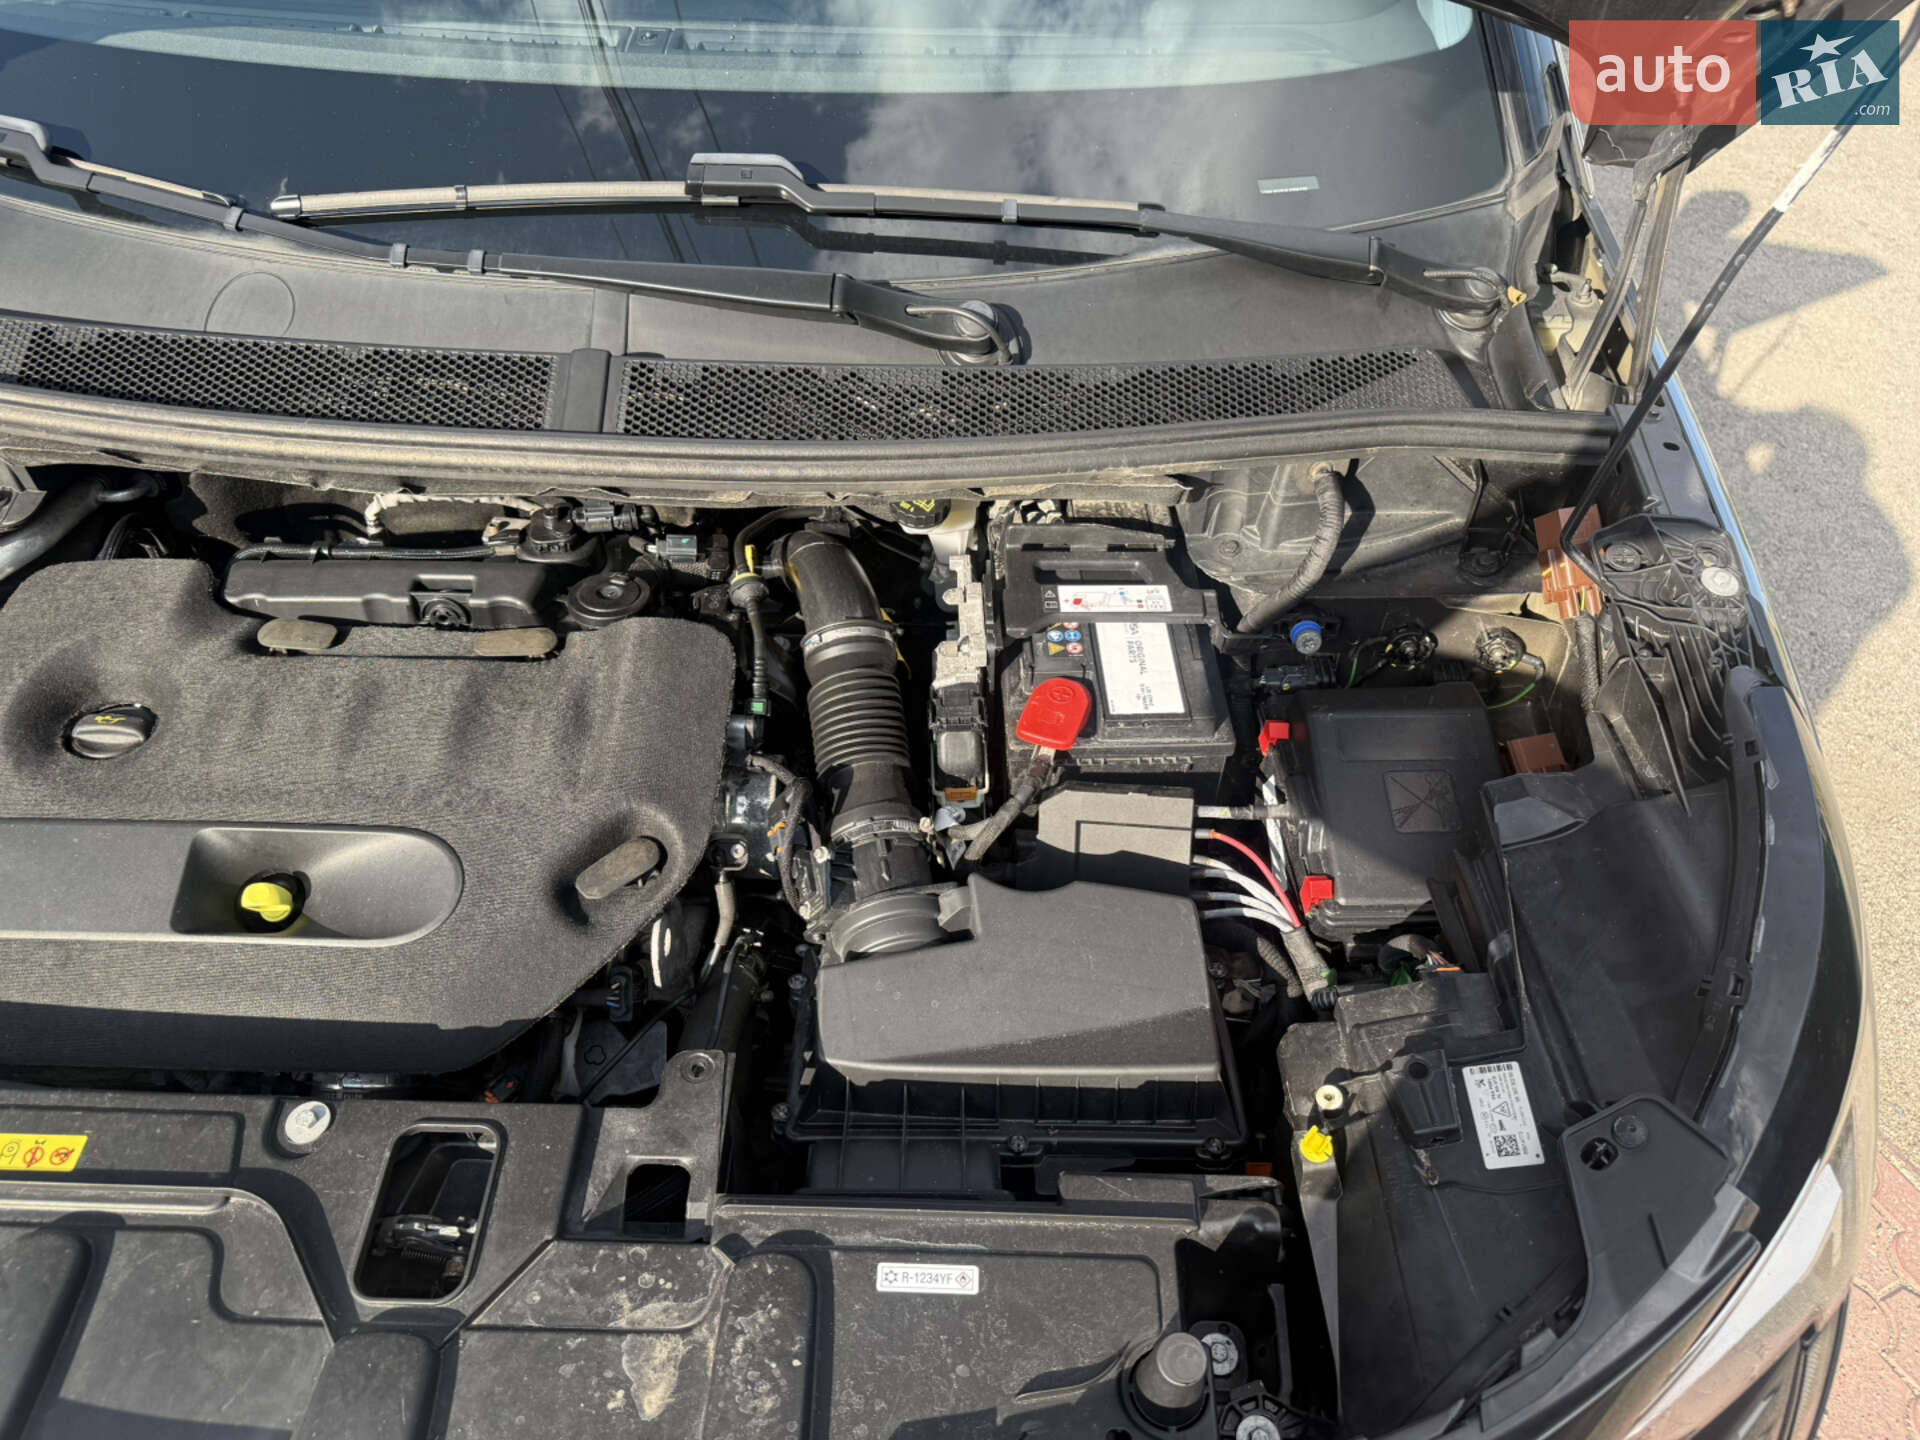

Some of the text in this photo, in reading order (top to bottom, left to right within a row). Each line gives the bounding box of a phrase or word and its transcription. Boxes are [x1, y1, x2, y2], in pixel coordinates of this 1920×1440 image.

[1126, 640, 1138, 664] PARTS
[1135, 640, 1149, 676] ORIGINAL
[901, 1271, 953, 1285] R-1234YF
